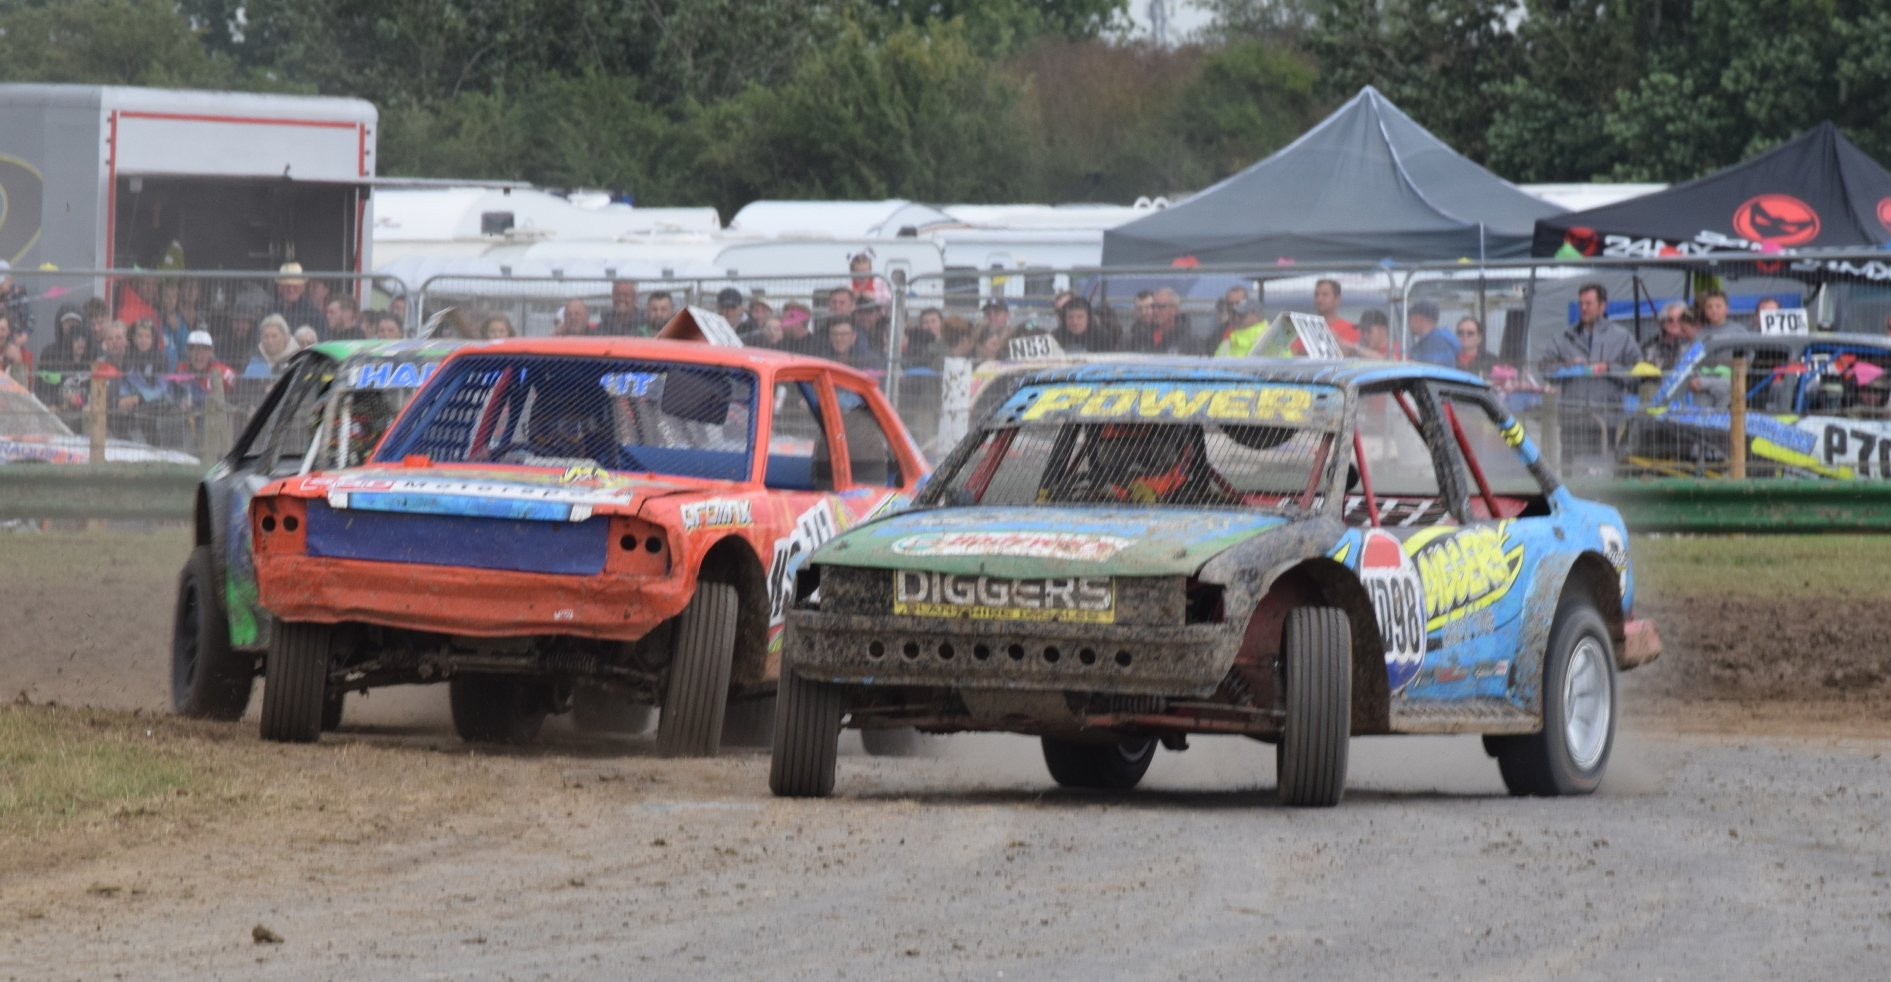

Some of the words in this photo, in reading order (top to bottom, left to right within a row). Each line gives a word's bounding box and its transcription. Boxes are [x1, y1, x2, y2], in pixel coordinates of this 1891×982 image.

[1765, 313, 1798, 331] P70
[1021, 387, 1313, 421] POWER
[1417, 524, 1511, 620] DIGGERS
[897, 571, 1113, 610] DIGGERS
